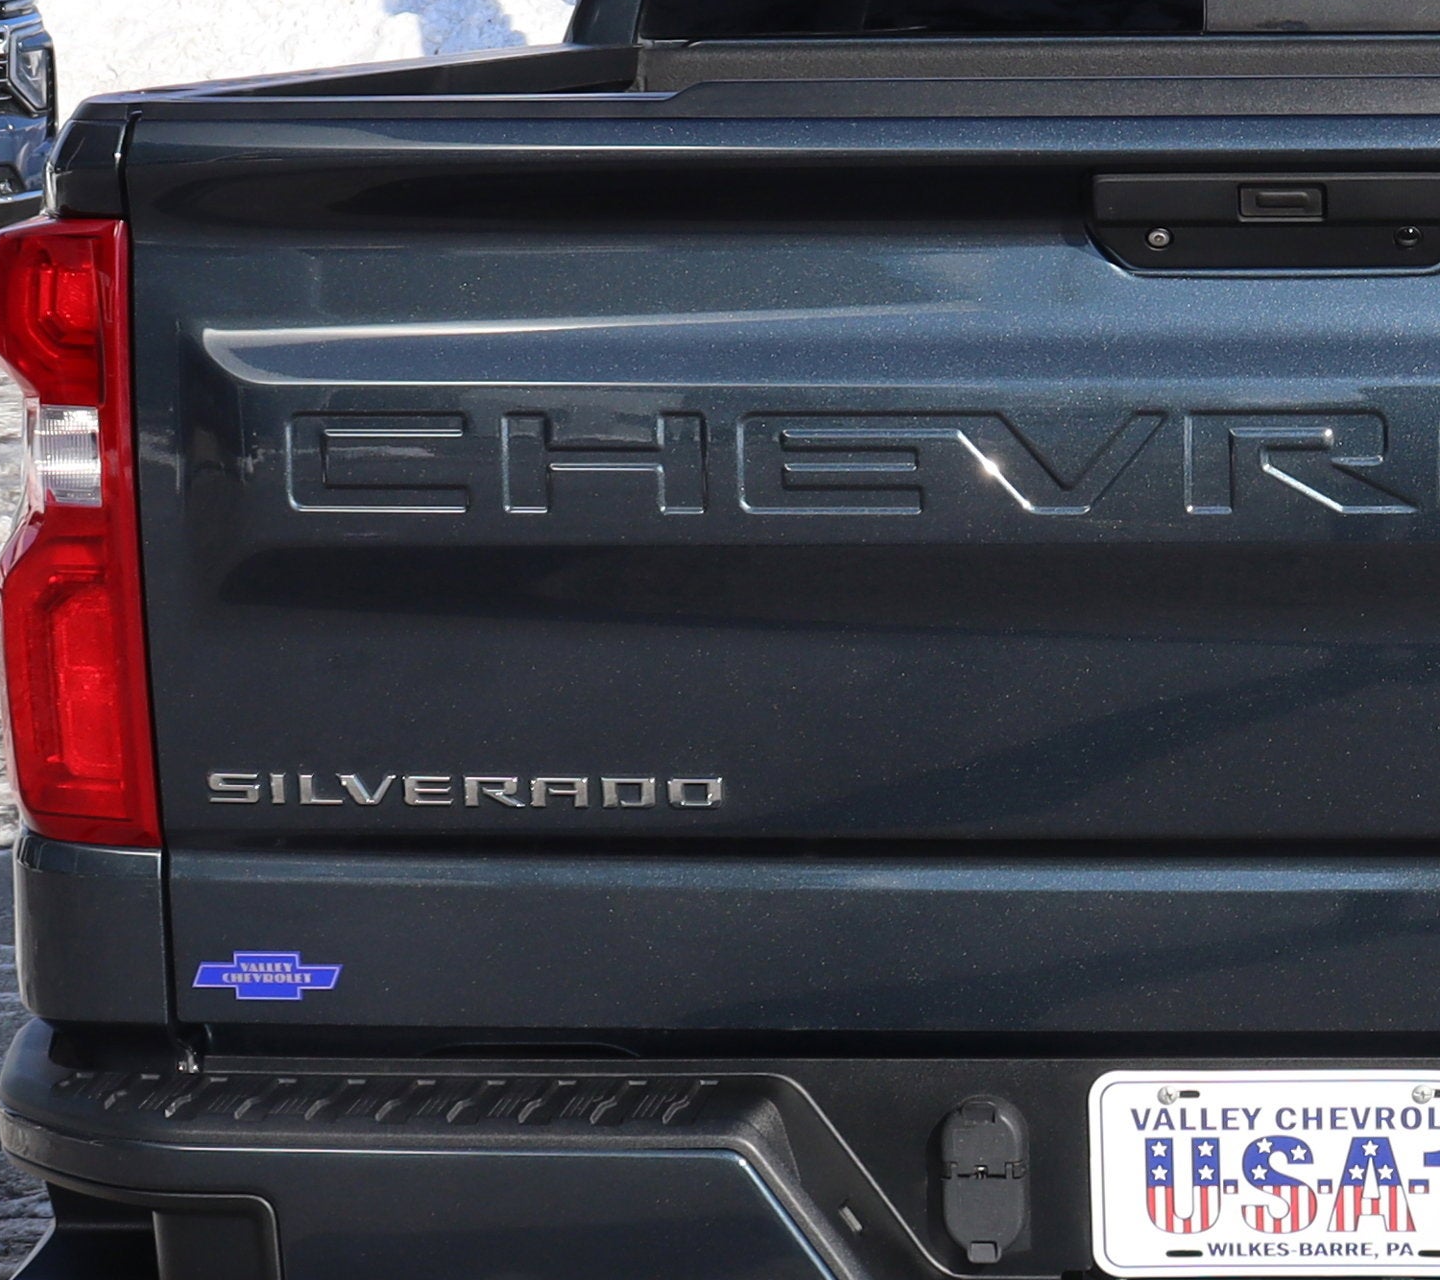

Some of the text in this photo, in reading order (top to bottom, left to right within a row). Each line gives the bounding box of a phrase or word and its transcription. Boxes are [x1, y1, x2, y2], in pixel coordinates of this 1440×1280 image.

[207, 771, 726, 810] SILVERADO
[240, 962, 293, 973] VALLEY
[222, 972, 312, 984] CHEVROLET
[1130, 1106, 1262, 1131] VALLEY
[1207, 1242, 1415, 1260] WILKES-BARRE, PA
